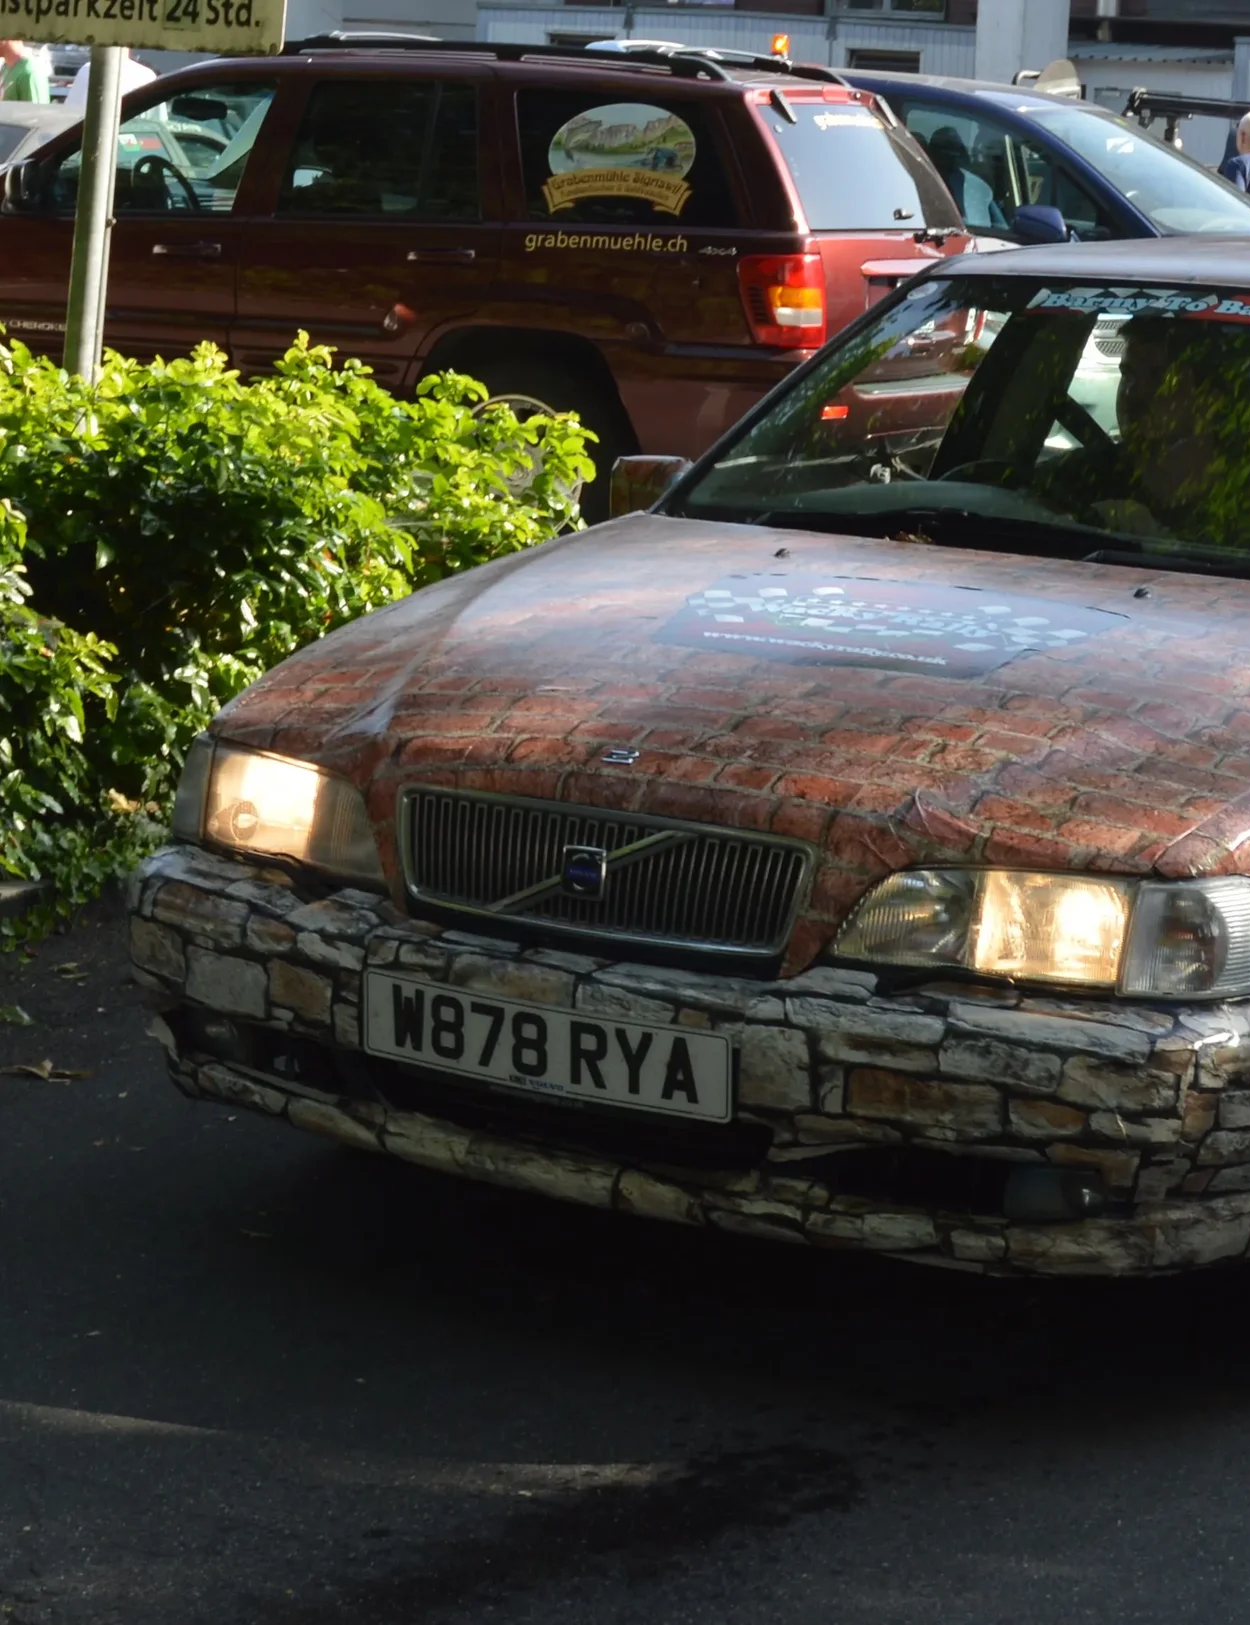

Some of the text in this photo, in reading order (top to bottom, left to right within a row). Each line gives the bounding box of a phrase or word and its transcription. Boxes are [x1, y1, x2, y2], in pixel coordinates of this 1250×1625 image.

[165, 0, 198, 24] 24
[205, 0, 261, 28] Std.
[524, 230, 688, 253] grabenmuehle.ch
[1040, 293, 1156, 312] Barmy
[1164, 296, 1210, 312] To
[9, 319, 67, 332] CHEROKE
[391, 983, 700, 1105] W878 RYA
